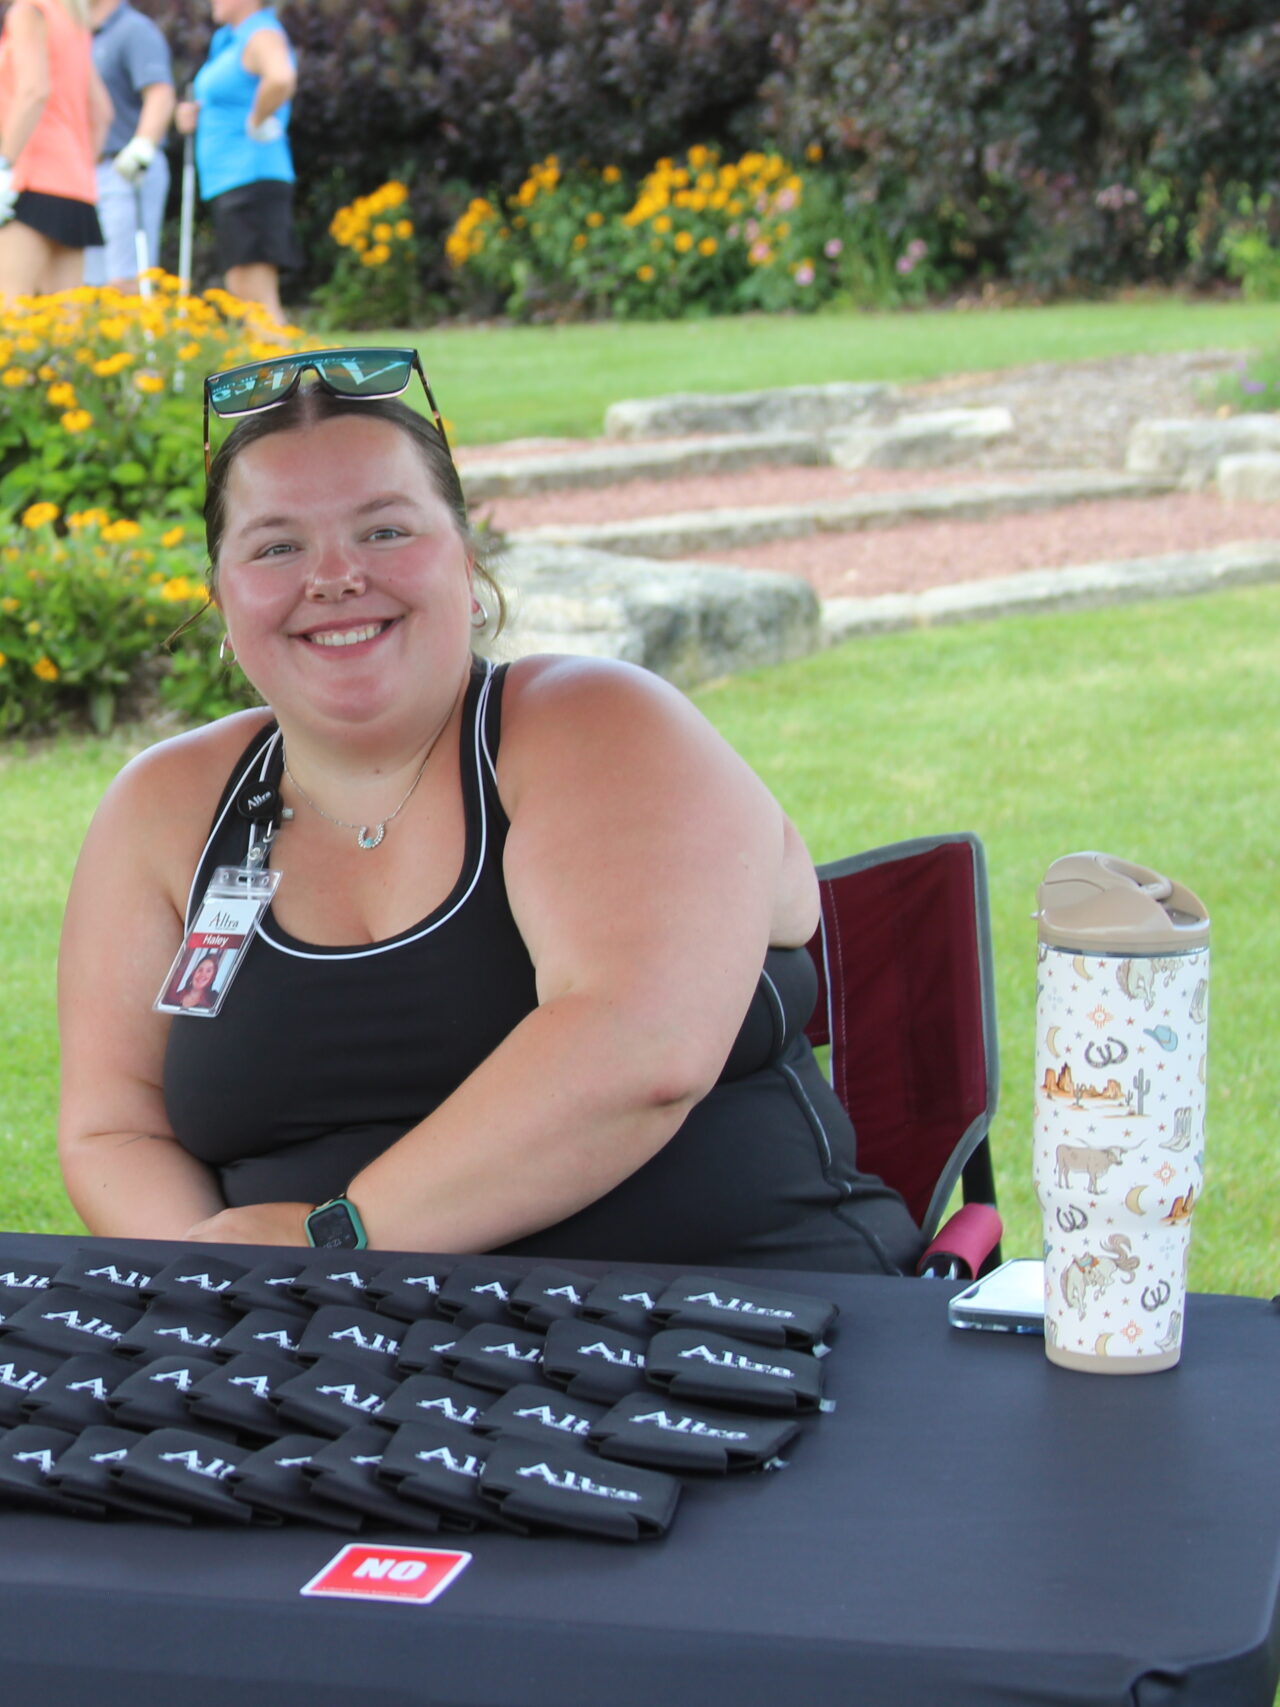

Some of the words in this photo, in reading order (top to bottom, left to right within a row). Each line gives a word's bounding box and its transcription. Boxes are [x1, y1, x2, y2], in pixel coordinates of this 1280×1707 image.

[208, 910, 239, 928] Altra
[202, 934, 229, 947] Haley
[684, 1291, 795, 1319] Altra
[678, 1345, 795, 1379] Altra
[629, 1410, 749, 1441] Altra
[516, 1463, 642, 1502] Altra
[352, 1557, 427, 1582] NO
